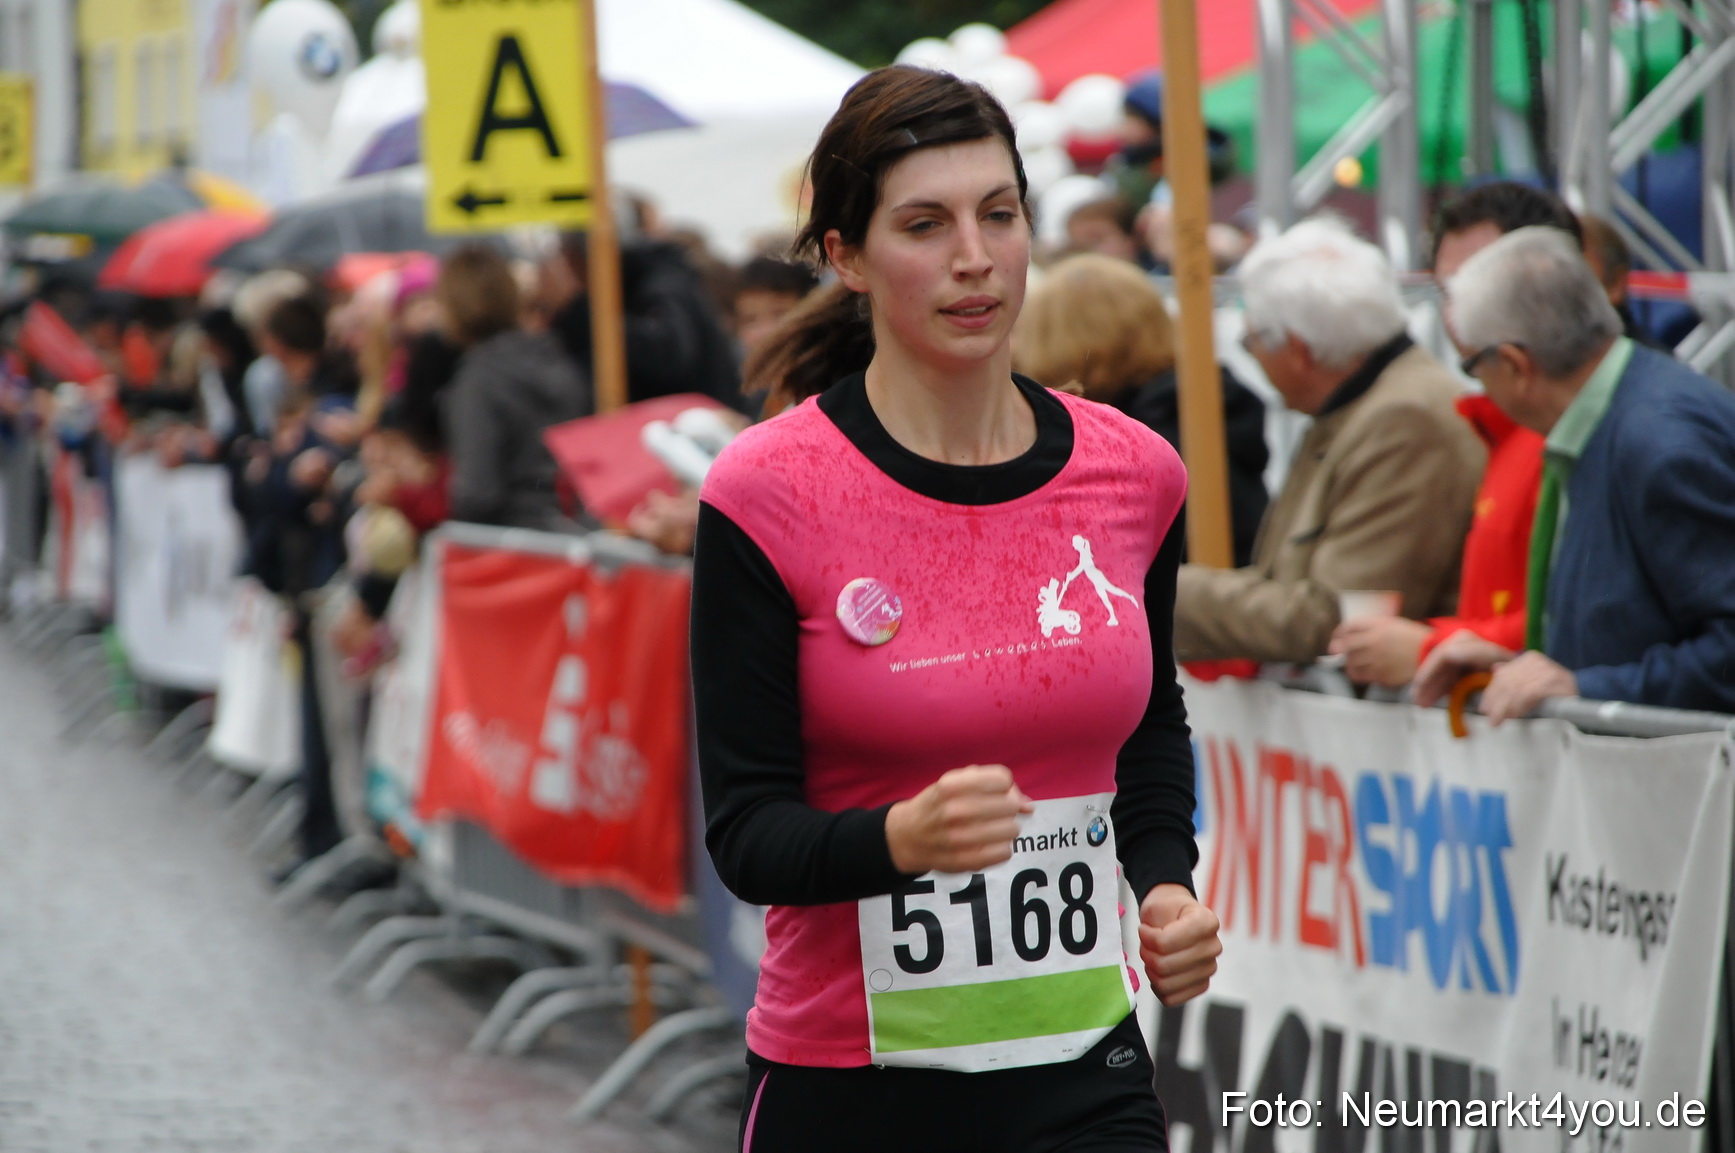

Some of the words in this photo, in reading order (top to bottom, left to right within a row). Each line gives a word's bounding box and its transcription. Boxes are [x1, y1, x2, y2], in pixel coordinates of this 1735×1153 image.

[470, 35, 563, 162] A
[889, 660, 908, 673] Wir
[910, 656, 939, 670] lieben
[940, 651, 967, 664] unser
[1012, 827, 1078, 853] markt
[889, 861, 1099, 975] 5168
